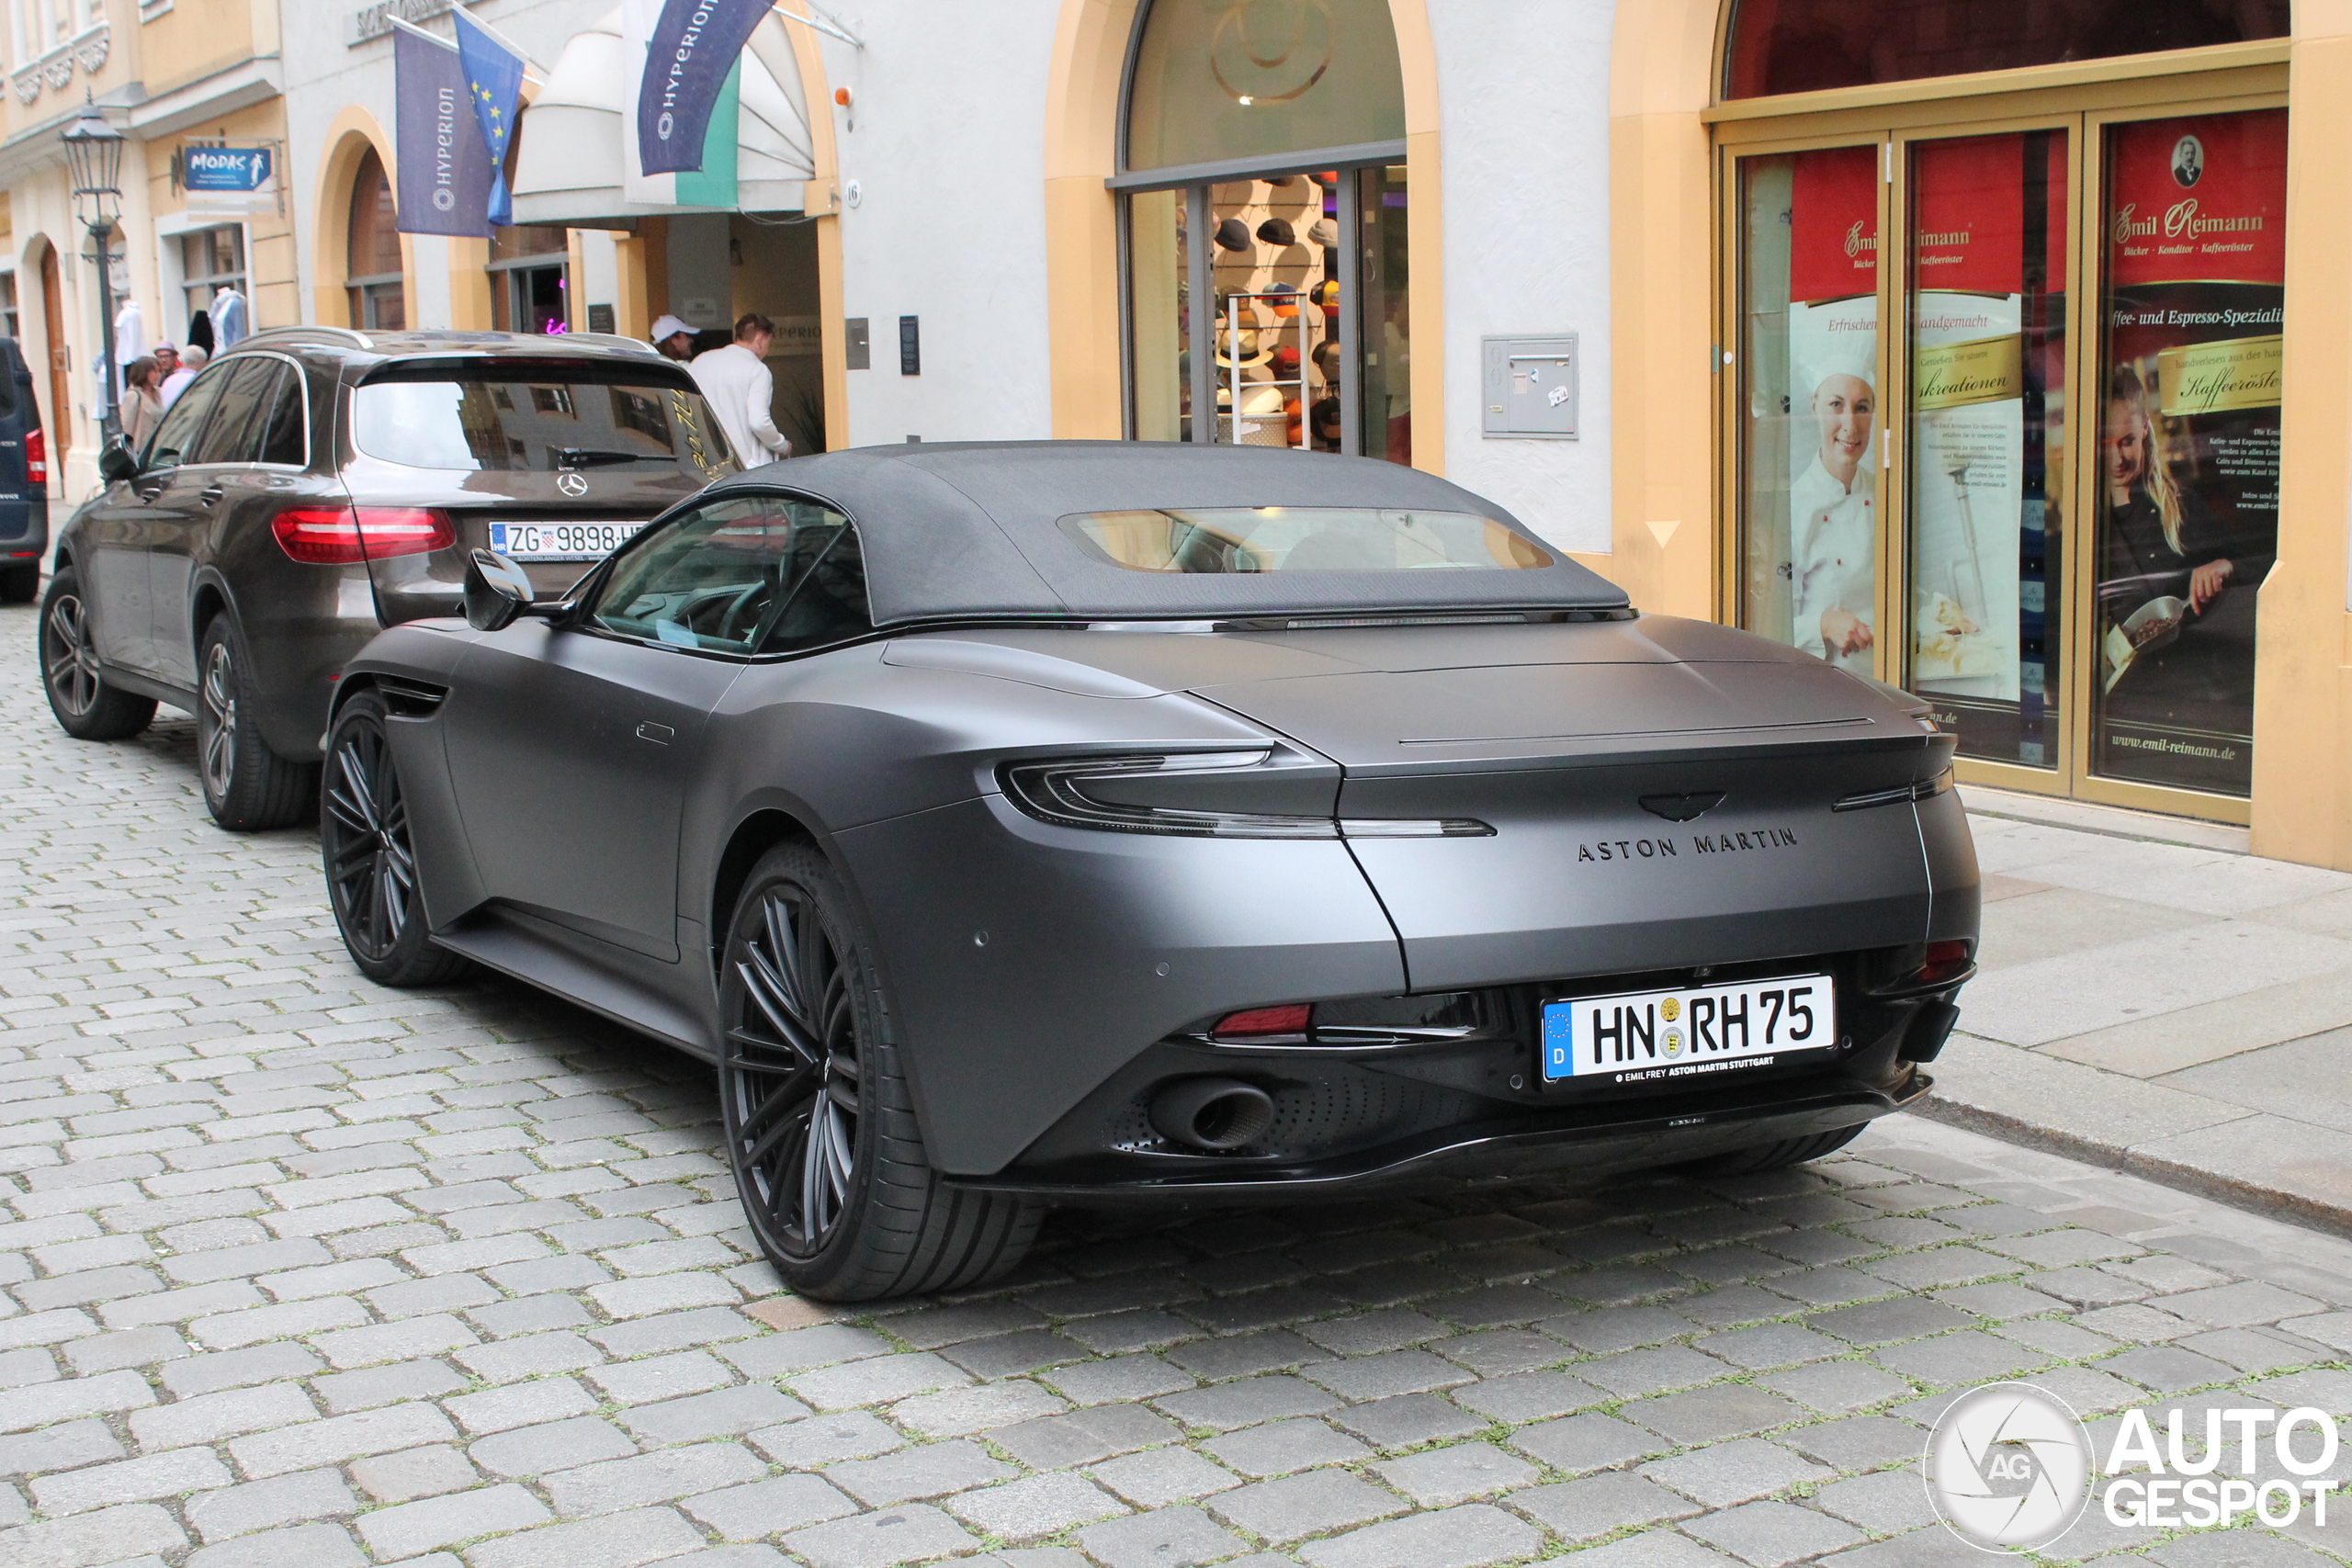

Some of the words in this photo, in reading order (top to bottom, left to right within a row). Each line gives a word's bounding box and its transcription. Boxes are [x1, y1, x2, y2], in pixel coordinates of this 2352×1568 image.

[436, 87, 454, 185] HYPERION
[190, 152, 246, 171] MODAS
[847, 184, 857, 201] 16
[2114, 203, 2157, 244] Emil
[2165, 197, 2263, 240] Reimann
[1844, 220, 1877, 258] Emi
[1920, 229, 1970, 246] imann
[2124, 247, 2149, 255] Bäcker
[2158, 245, 2194, 254] Konditor
[2201, 243, 2254, 254] Kaffeeröster
[1828, 319, 1877, 333] Erfrischen
[1920, 315, 1987, 332] andgemacht
[2113, 310, 2136, 327] ffee-
[2139, 310, 2165, 325] und
[2167, 307, 2284, 327] Espresso-Speziali
[1954, 353, 1965, 361] Sie
[2246, 351, 2261, 360] der
[2265, 349, 2282, 358] hau
[1919, 367, 2009, 398] skreationen
[2180, 367, 2282, 412] Kaffeeröste
[493, 543, 506, 551] HR
[509, 526, 539, 552] ZG
[2112, 736, 2235, 761] www.emil-reimann.de
[1578, 839, 1677, 862] ASTON
[1693, 828, 1797, 853] MARTIN
[1593, 1004, 1655, 1064] HN
[1554, 1047, 1565, 1065] D
[1625, 1073, 1645, 1082] EMIL
[1645, 1069, 1667, 1079] FREY
[1668, 1066, 1697, 1077] ASTON
[1698, 1062, 1728, 1074] MARTIN
[1729, 1056, 1774, 1070] STUTTGART
